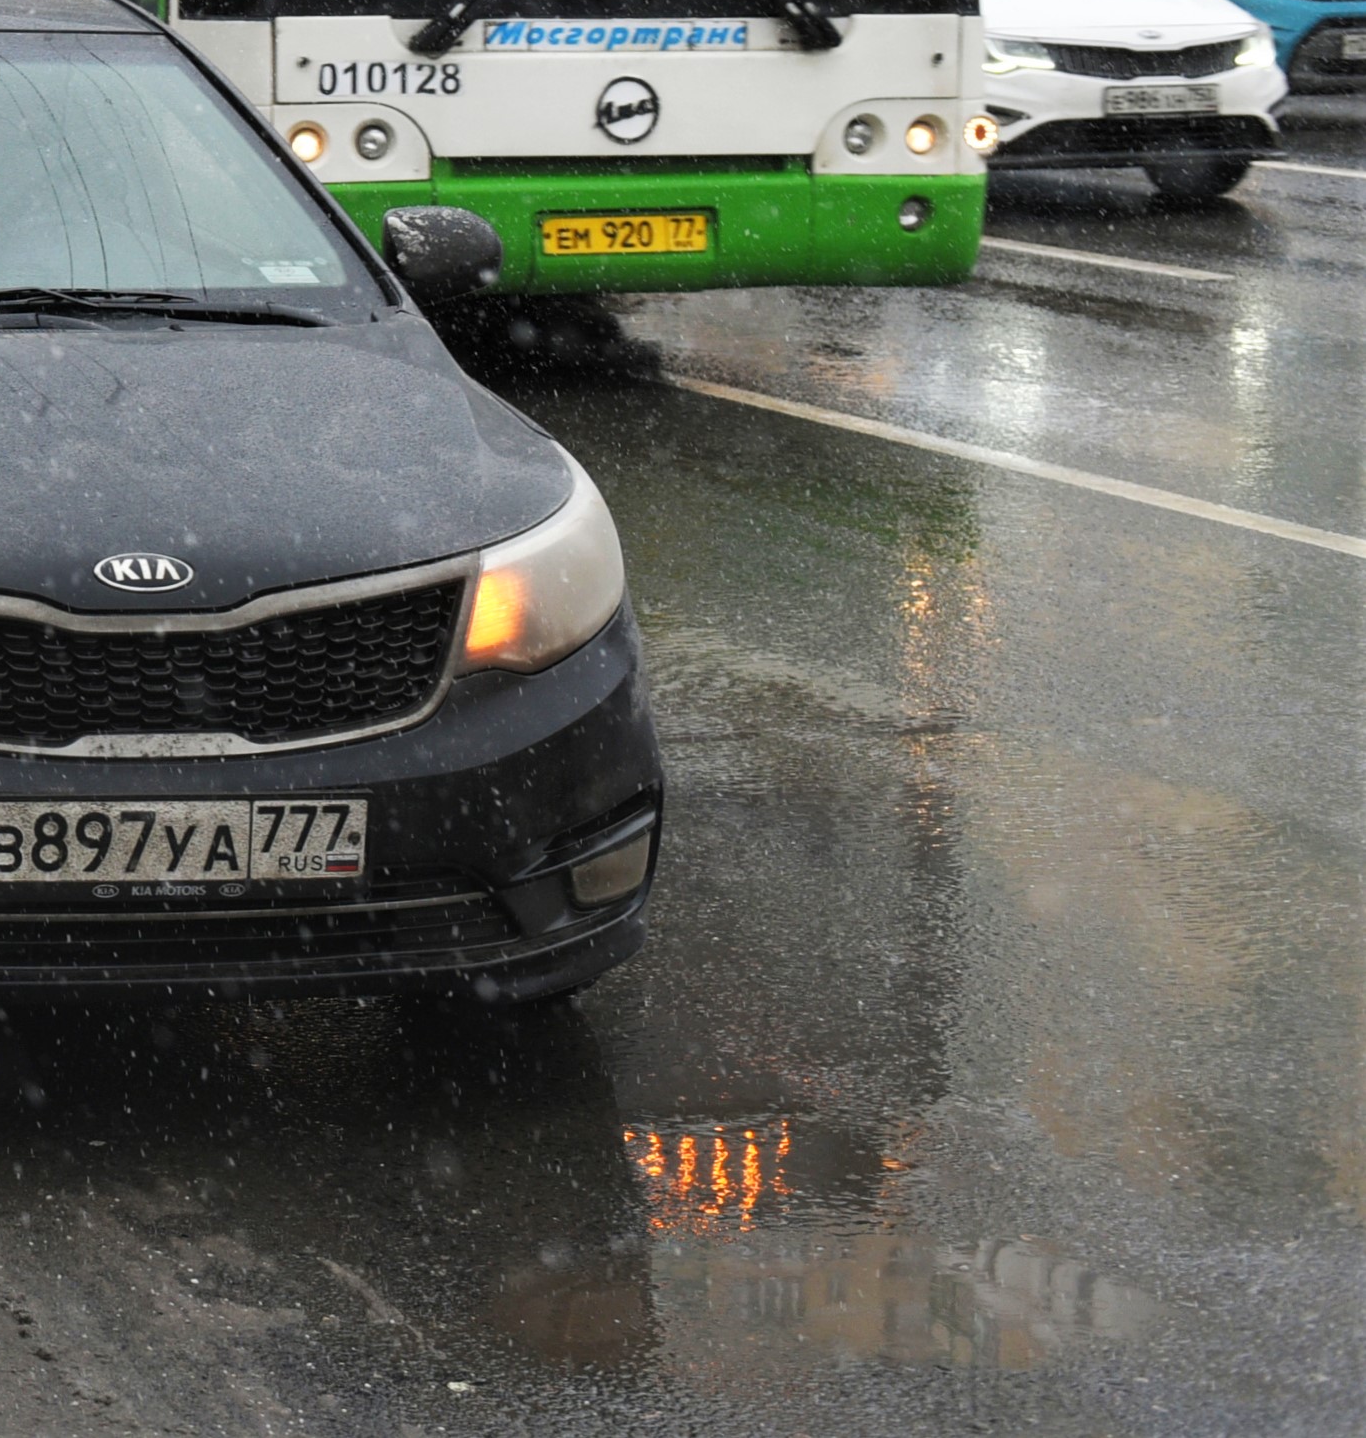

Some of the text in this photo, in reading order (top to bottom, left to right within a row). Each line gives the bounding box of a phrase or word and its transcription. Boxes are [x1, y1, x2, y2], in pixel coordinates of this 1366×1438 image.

[484, 21, 747, 51] Мосгортранс
[318, 62, 462, 95] 010128
[556, 218, 696, 250] ЕМ 920 77
[109, 558, 182, 582] KIA
[257, 805, 351, 853] 777
[278, 856, 324, 872] RUS
[131, 886, 152, 896] KIA
[155, 885, 207, 896] MOTORS
